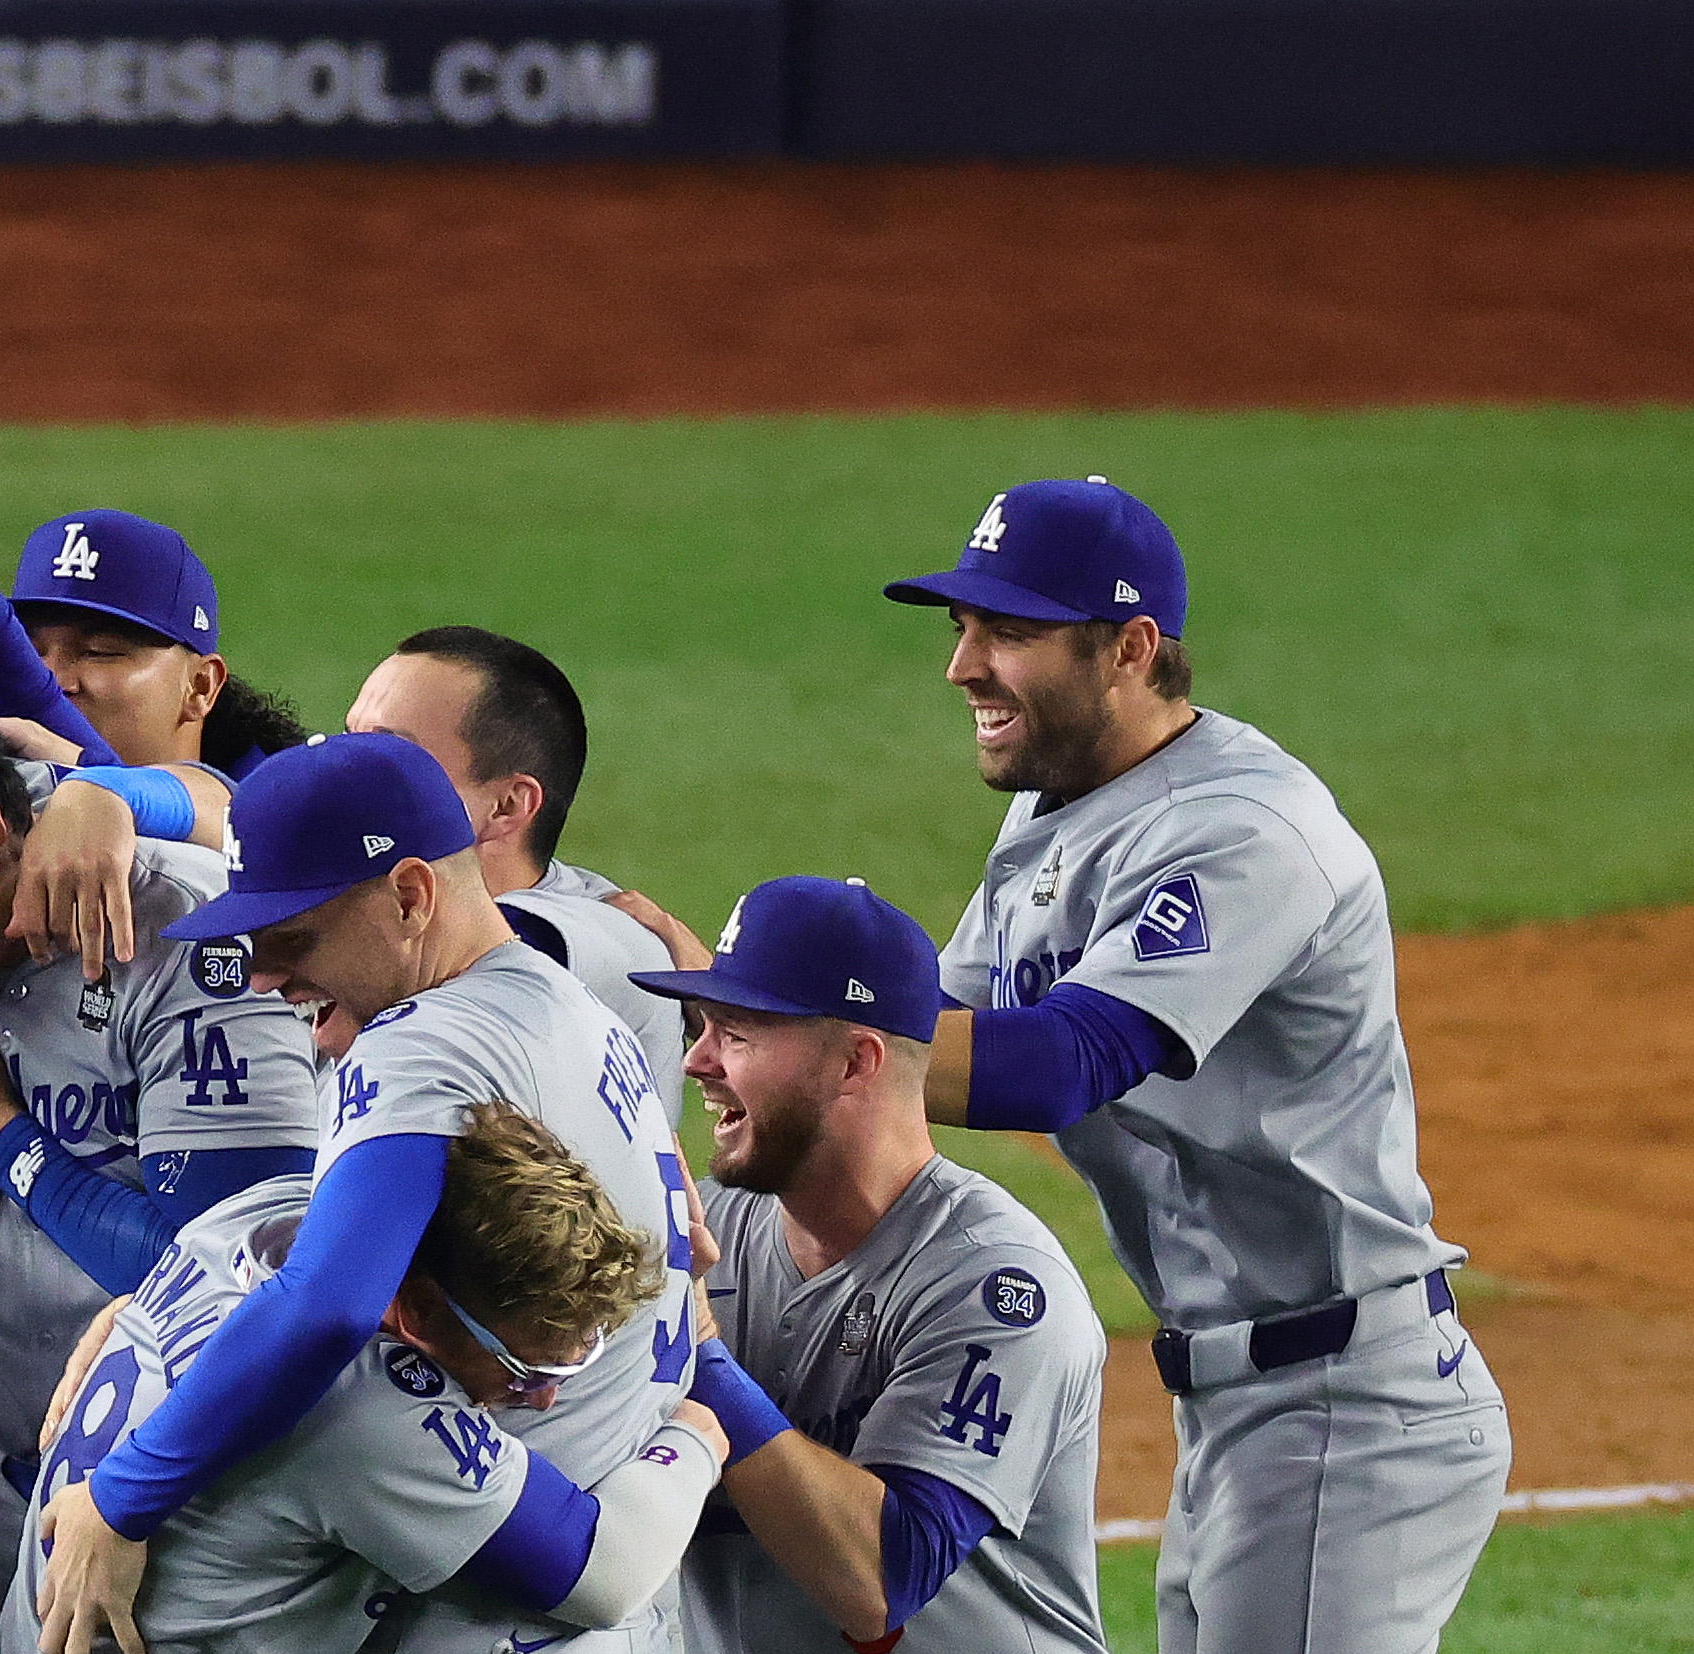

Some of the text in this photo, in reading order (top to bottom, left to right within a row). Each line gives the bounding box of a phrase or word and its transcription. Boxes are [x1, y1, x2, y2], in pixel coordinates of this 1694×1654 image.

[52, 523, 100, 581] LA
[204, 957, 244, 988] 34
[179, 1008, 249, 1107] LA
[996, 1286, 1035, 1320] 34
[940, 1342, 1013, 1458] LA
